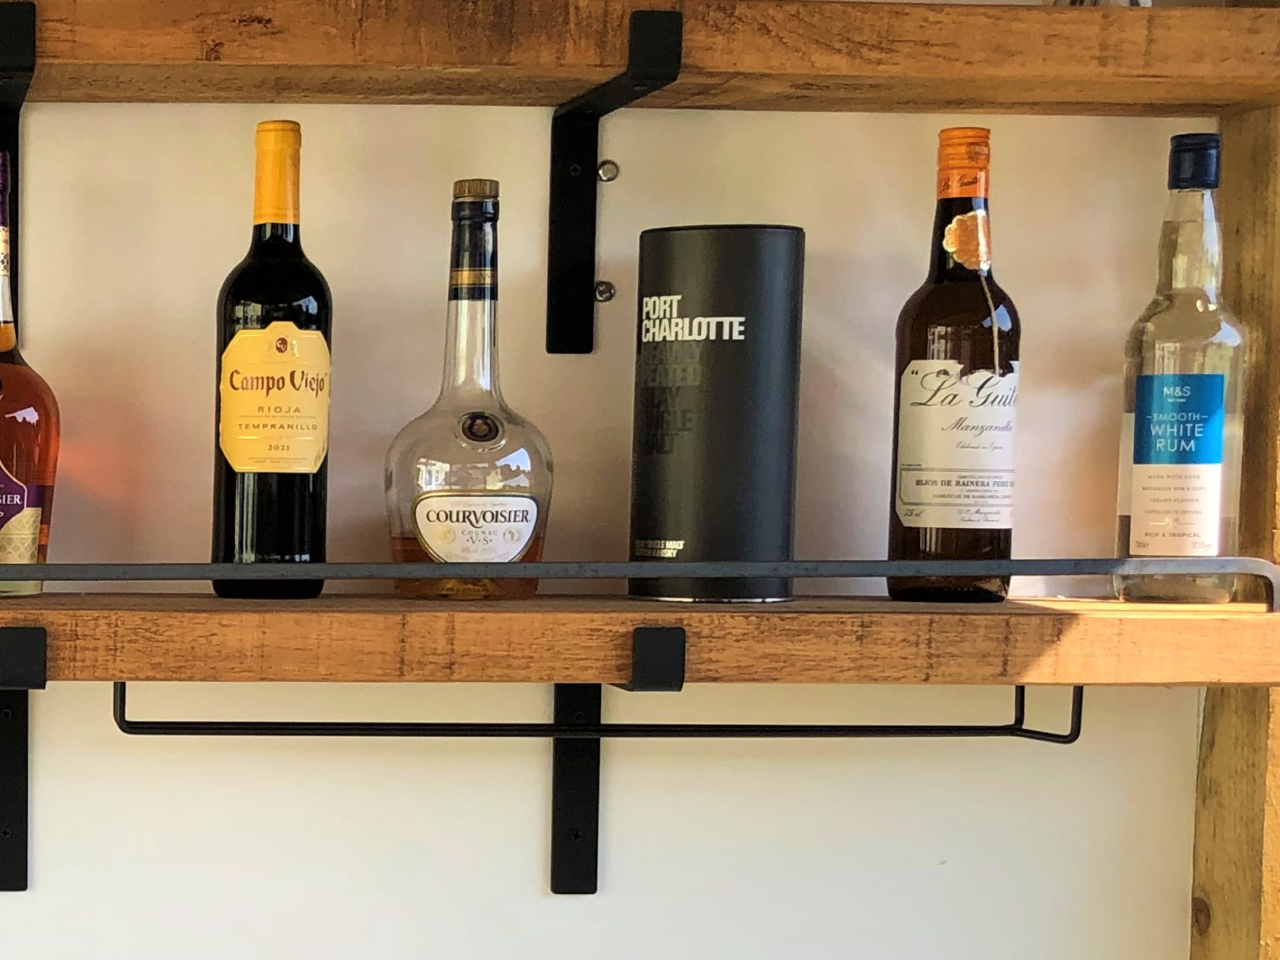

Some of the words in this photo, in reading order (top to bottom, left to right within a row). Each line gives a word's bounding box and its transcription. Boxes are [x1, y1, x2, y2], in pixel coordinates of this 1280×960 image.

[642, 294, 683, 320] PORT
[641, 316, 746, 343] CHARLOTTE
[229, 369, 286, 398] Campo
[289, 369, 325, 399] Viejo
[1163, 386, 1191, 397] M&S
[257, 405, 302, 414] RIOJA
[1152, 413, 1200, 421] SMOOTH
[238, 423, 318, 431] TEMPRANILLO
[1150, 423, 1204, 437] WHITE
[1156, 439, 1196, 452] RUM
[426, 509, 530, 529] COURVOISIER
